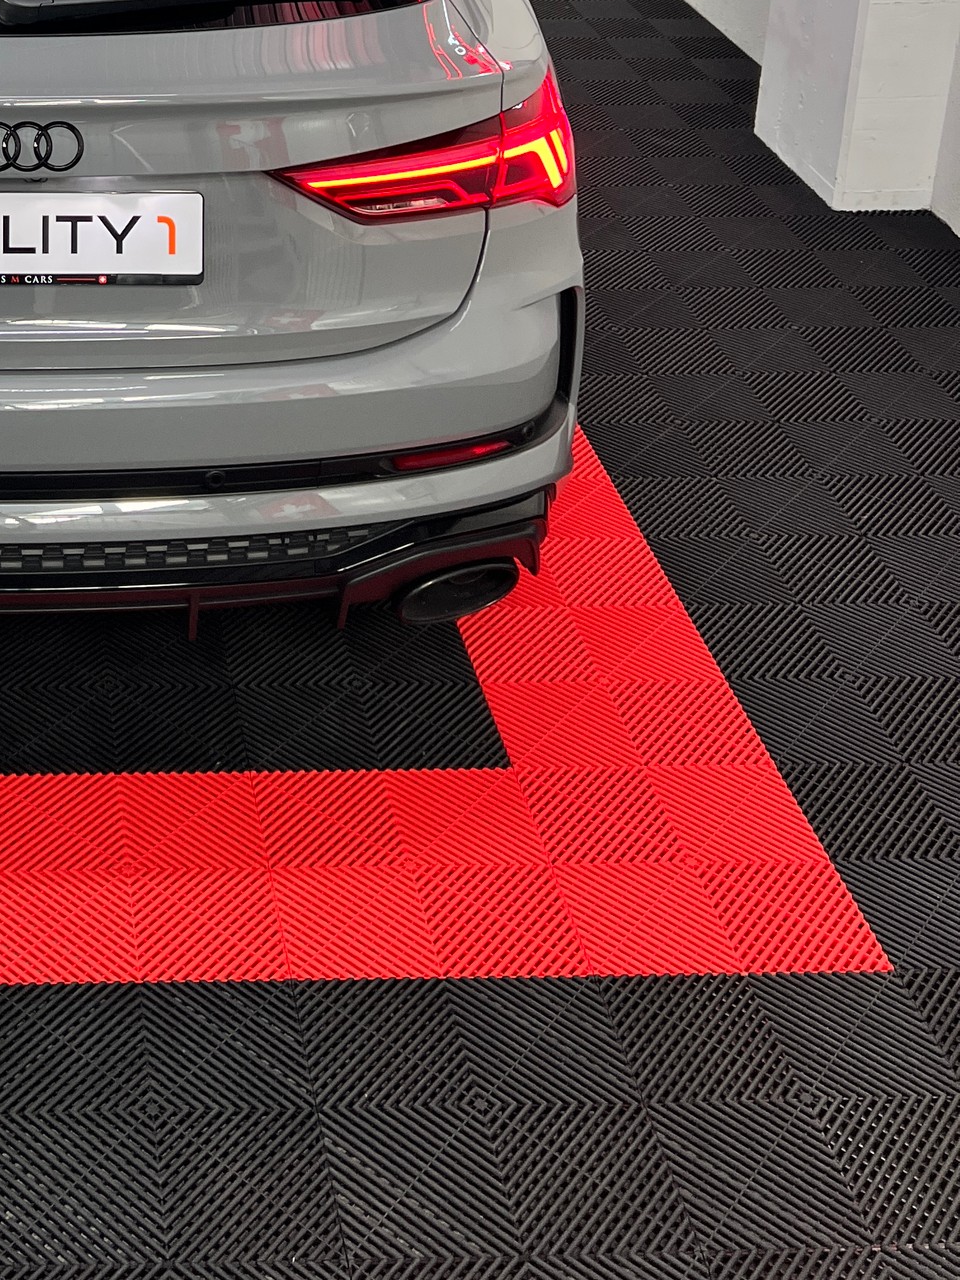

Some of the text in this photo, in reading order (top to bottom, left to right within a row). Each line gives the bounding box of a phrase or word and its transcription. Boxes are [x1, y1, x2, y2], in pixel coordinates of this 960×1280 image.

[157, 215, 176, 254] 1
[10, 275, 20, 284] M
[24, 275, 53, 284] CARS
